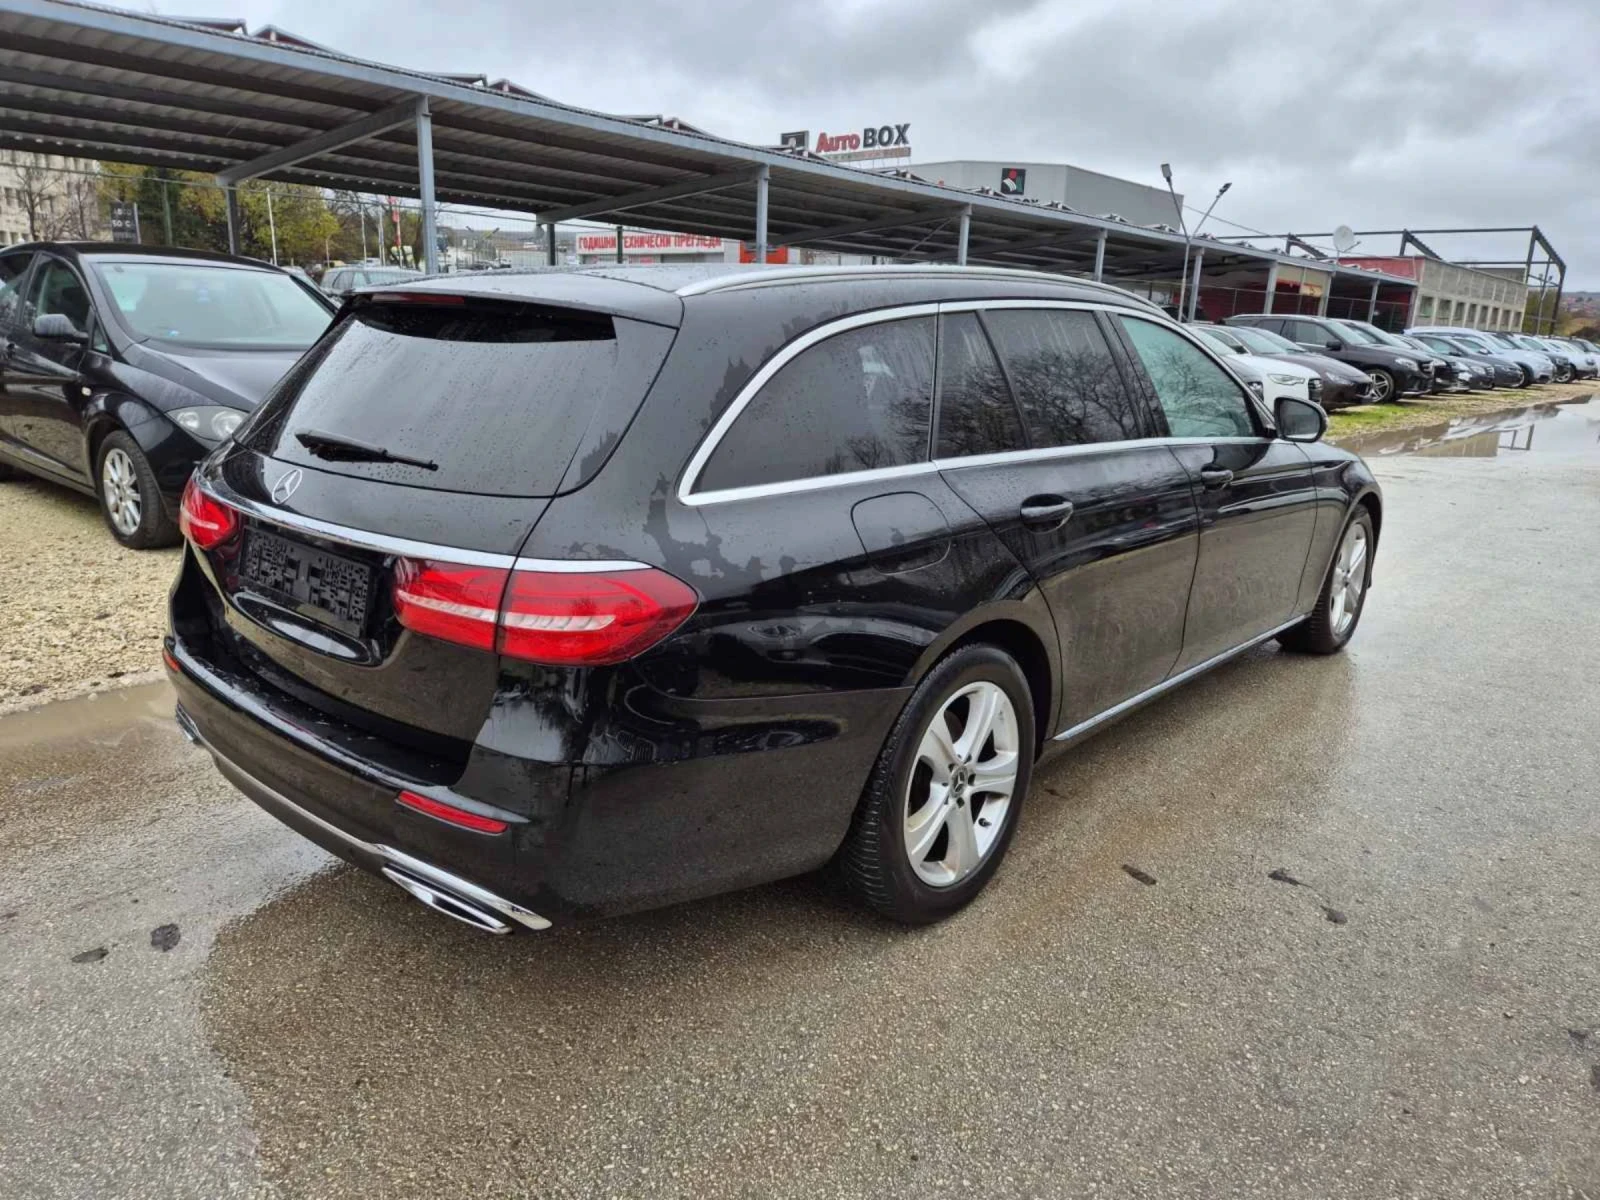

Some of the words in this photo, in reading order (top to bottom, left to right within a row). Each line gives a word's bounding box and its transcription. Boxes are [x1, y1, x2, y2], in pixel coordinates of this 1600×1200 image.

[863, 123, 911, 149] BOX
[578, 236, 617, 250] ГОДИШНИ
[621, 235, 671, 249] ЕХНИЧЕСКИ
